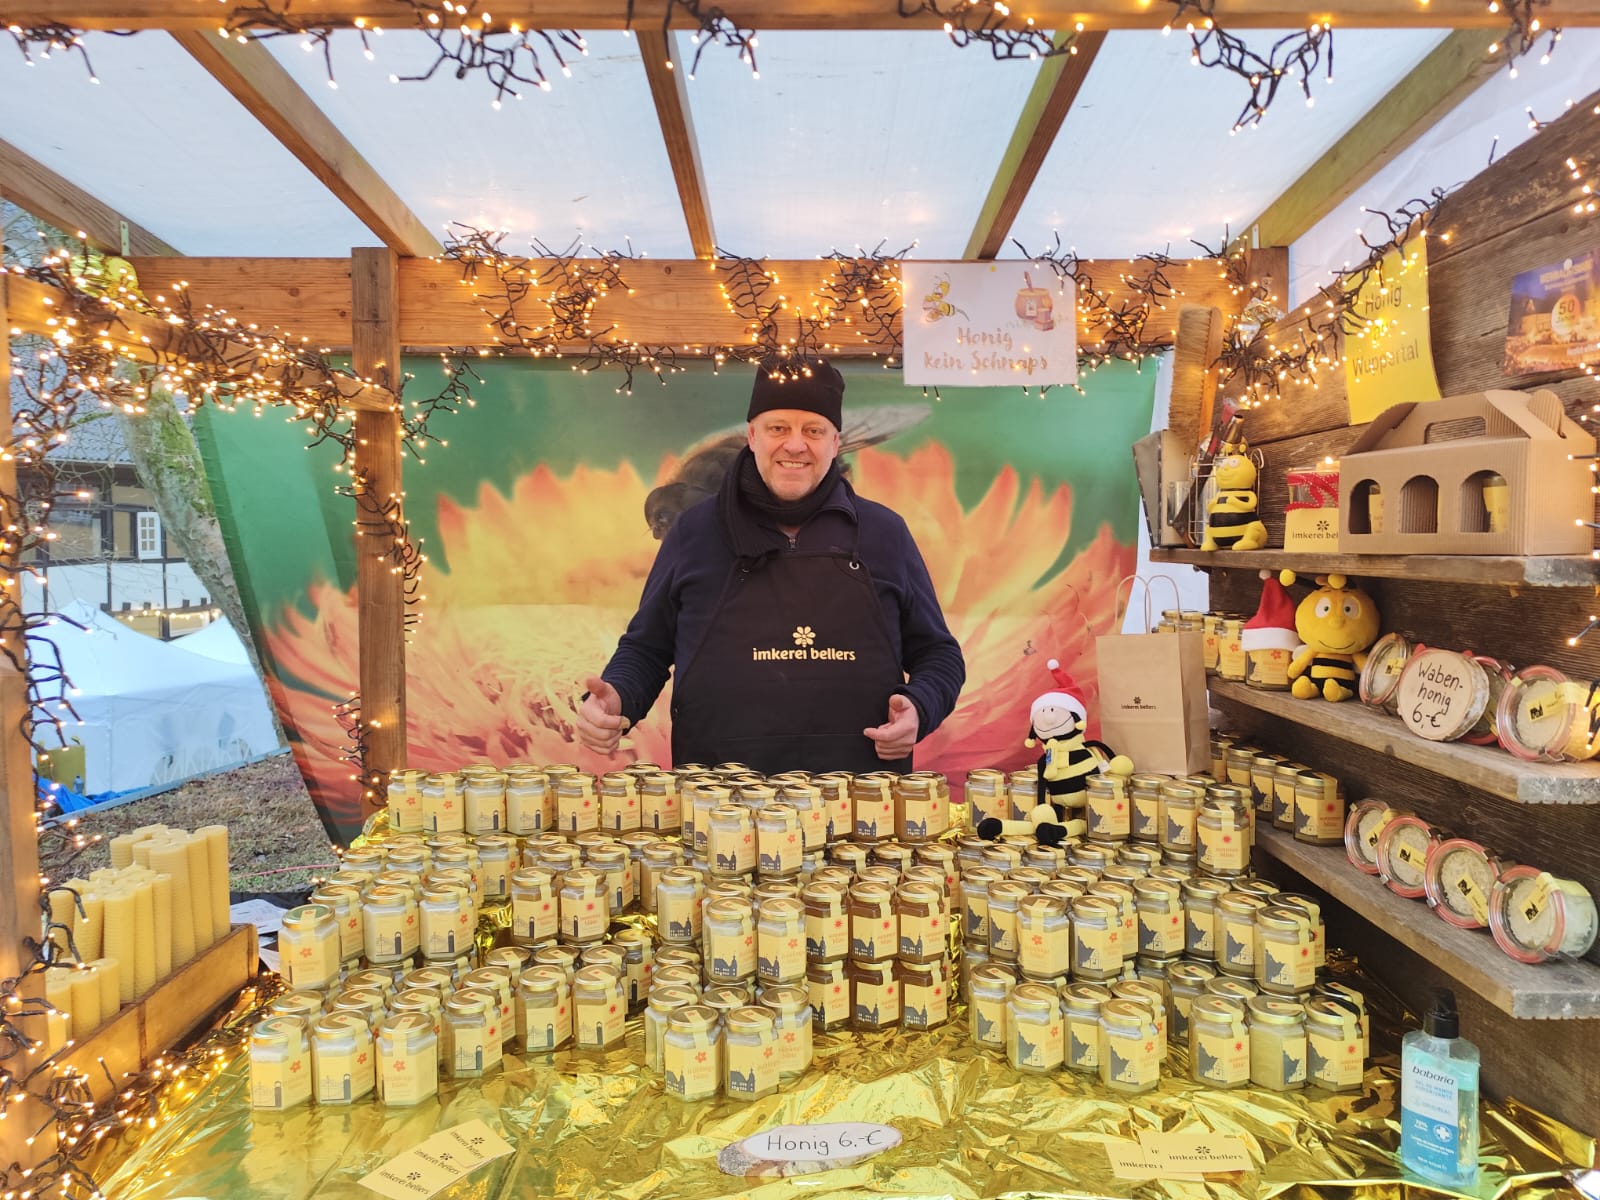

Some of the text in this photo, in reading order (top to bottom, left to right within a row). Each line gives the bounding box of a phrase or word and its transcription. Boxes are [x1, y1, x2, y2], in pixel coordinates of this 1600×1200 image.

[957, 327, 1013, 350] Honig
[924, 350, 1048, 375] kein Schnaps
[1352, 338, 1419, 376] Wuppertal
[752, 647, 856, 661] imkerei bellers
[1418, 661, 1464, 691] Waben-
[1418, 682, 1452, 715] honig
[1412, 1066, 1454, 1085] babaria
[450, 1130, 484, 1159] imkerei bellers
[767, 1135, 829, 1156] Honig
[1169, 1153, 1244, 1161] imkerei bellers
[414, 1148, 461, 1174] imkerei bellers
[1119, 1160, 1158, 1169] imkerei
[379, 1169, 429, 1194] imkerei bellers
